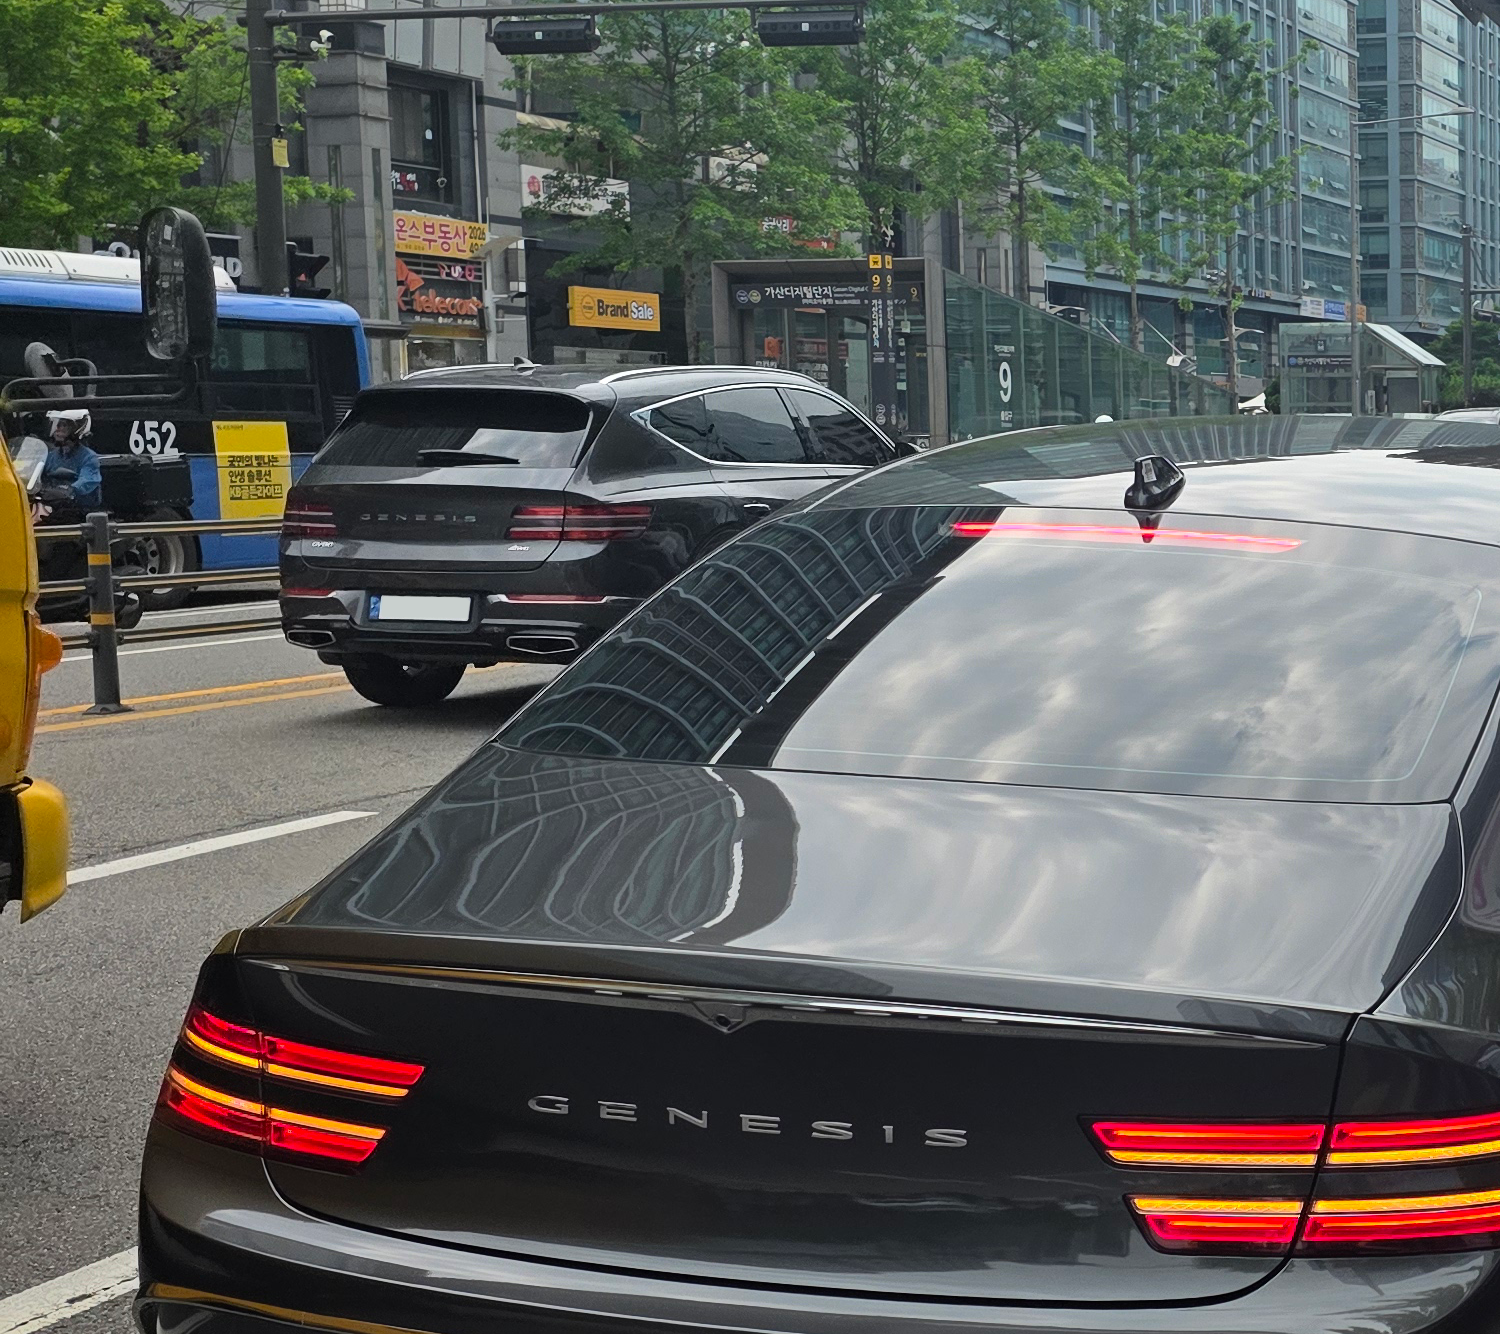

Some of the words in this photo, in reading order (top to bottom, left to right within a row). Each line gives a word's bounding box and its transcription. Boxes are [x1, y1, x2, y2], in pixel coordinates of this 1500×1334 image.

[468, 225, 487, 241] 2026
[872, 274, 881, 287] 9
[886, 274, 892, 287] 9
[764, 285, 833, 299] 가산디지털단지
[910, 287, 918, 298] 9
[597, 298, 629, 318] Brand
[629, 300, 655, 321] Sale
[998, 361, 1012, 403] 9
[128, 420, 180, 455] 652
[228, 469, 245, 484] 인생
[359, 513, 476, 523] GENESIS
[527, 1095, 968, 1148] GENESIS
